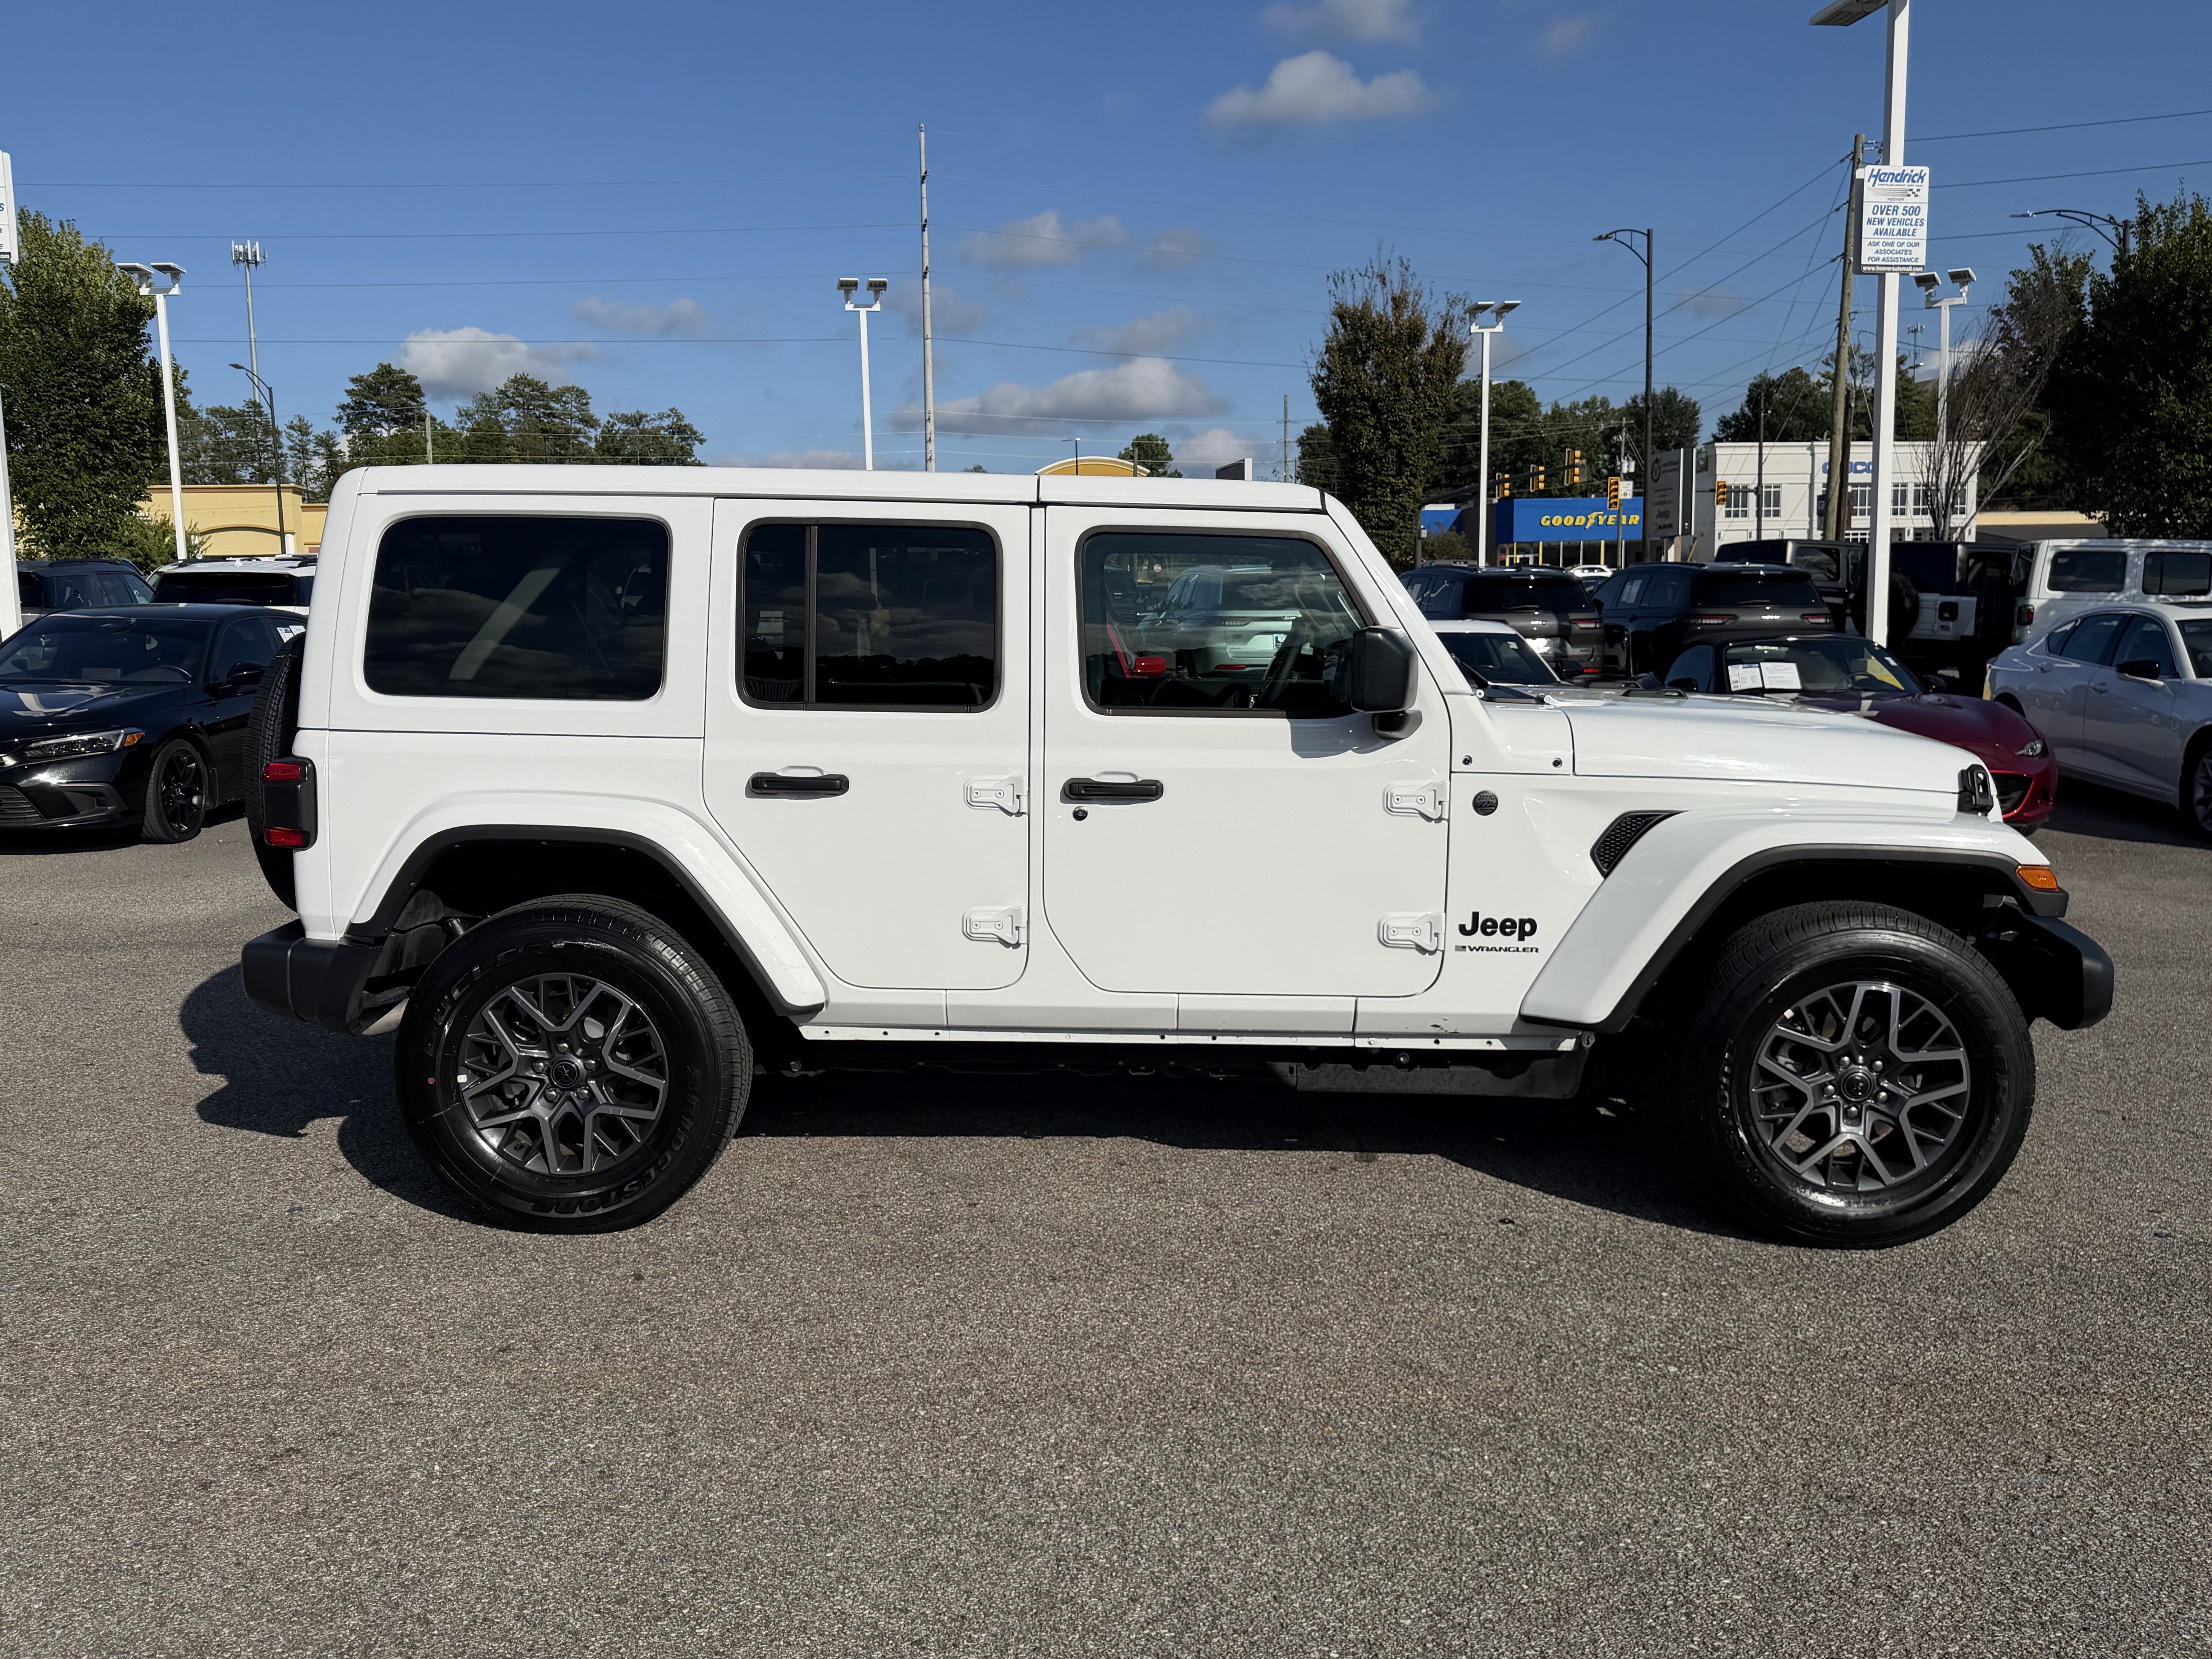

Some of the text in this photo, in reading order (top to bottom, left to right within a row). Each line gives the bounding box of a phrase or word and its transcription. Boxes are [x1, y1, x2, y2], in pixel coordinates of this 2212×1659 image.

[1867, 168, 1927, 187] Hendrick
[1872, 205, 1921, 216] OVER 500
[1867, 217, 1925, 227] NEW VEHICLES
[1873, 228, 1917, 237] AVAILABLE
[1458, 911, 1537, 942] Jeep
[1467, 945, 1539, 953] WRANGLER
[531, 1064, 702, 1214] BRIDGESTONE
